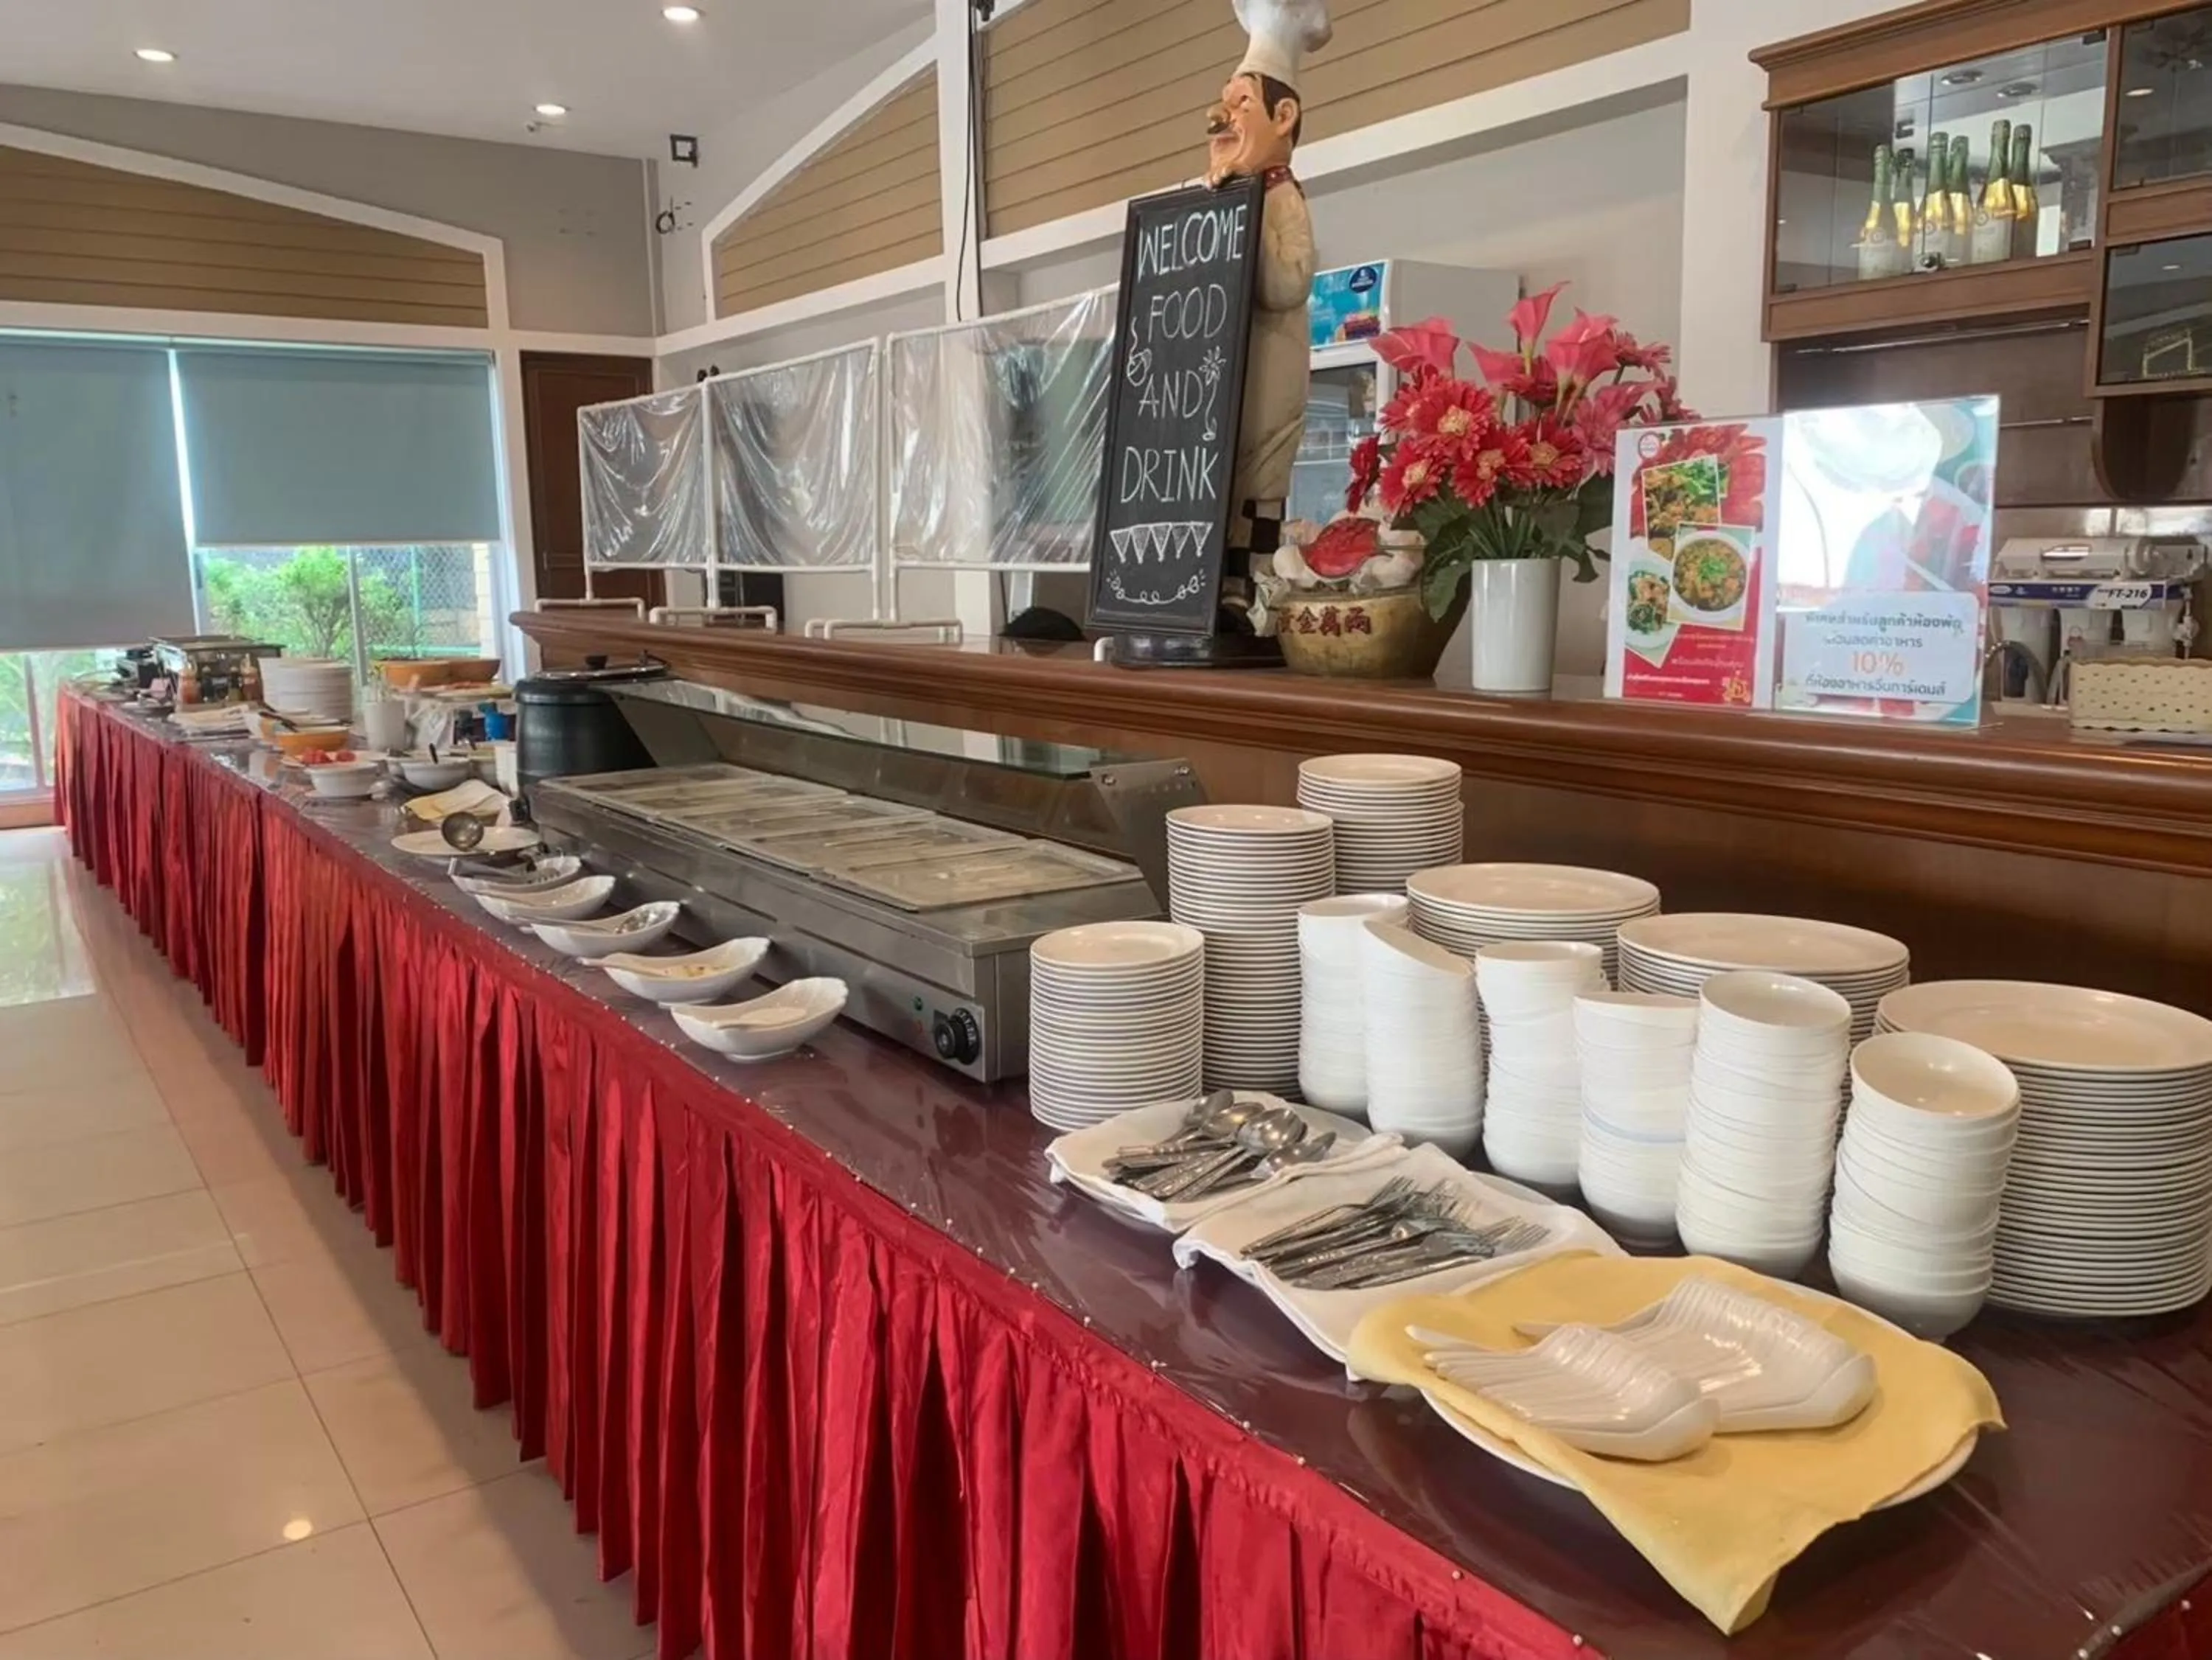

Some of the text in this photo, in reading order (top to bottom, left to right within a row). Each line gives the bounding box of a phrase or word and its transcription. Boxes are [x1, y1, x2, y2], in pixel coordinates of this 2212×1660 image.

[1136, 203, 1248, 283] WELCOME
[1147, 283, 1228, 343] FOOD
[1138, 370, 1205, 419] AND
[1120, 445, 1220, 505] DRINK
[1851, 650, 1905, 677] 10%
